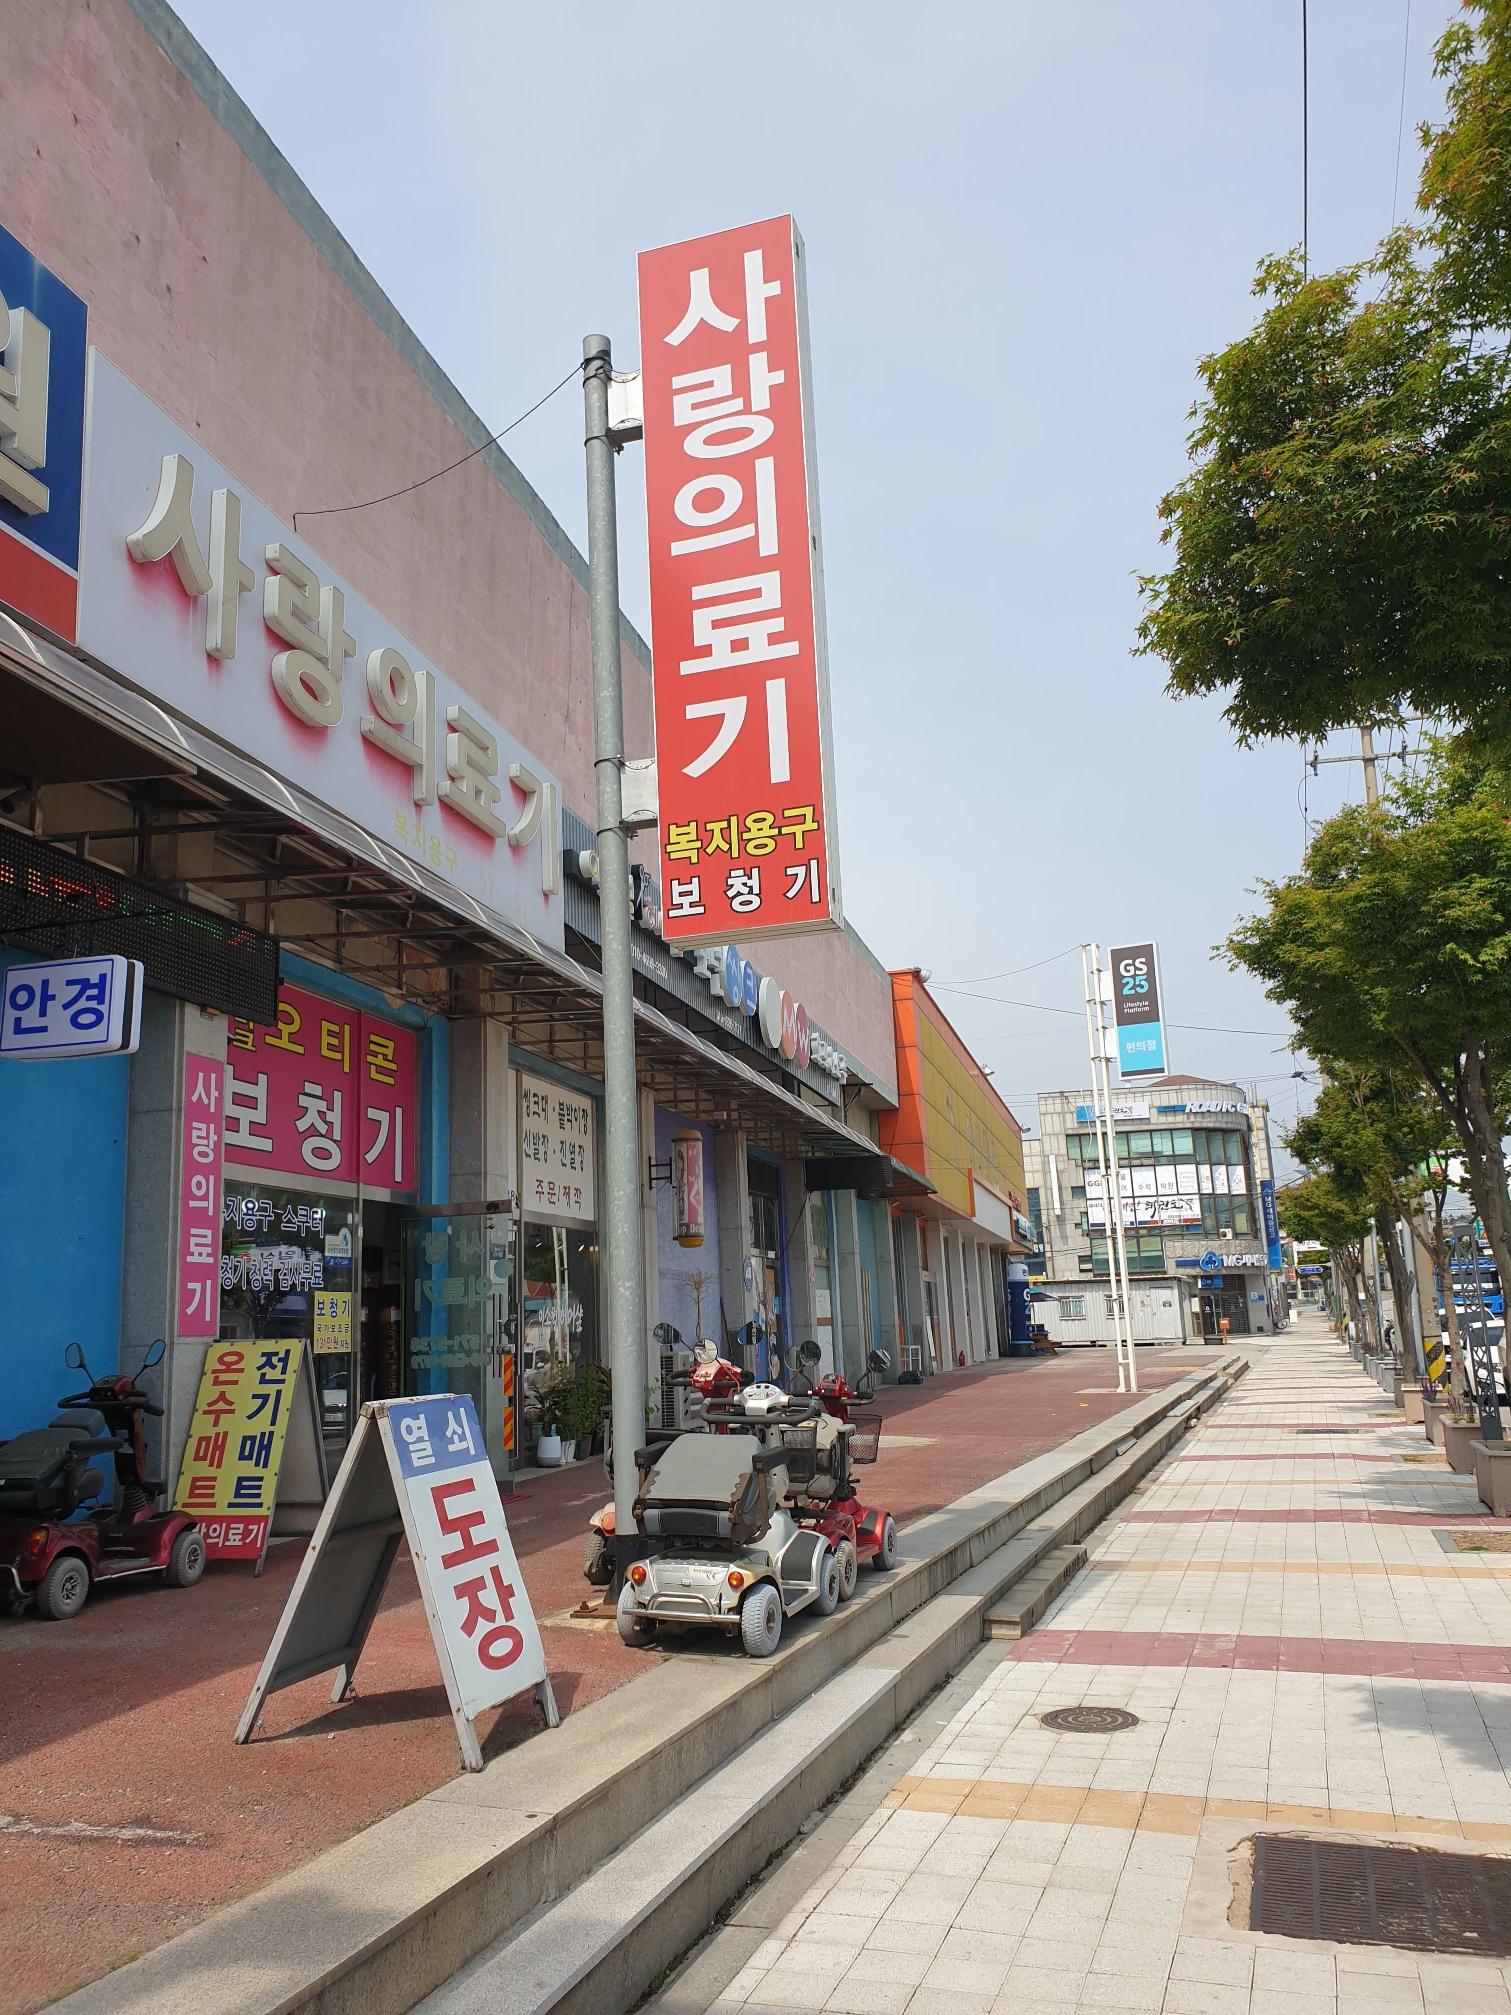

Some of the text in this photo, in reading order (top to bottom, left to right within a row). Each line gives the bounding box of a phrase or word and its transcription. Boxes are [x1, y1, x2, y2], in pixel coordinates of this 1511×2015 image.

[663, 248, 800, 785] 사랑의료기
[126, 453, 560, 895] 사랑의료기
[394, 810, 459, 873] 복지용구
[664, 804, 819, 864] 복지용구
[667, 859, 821, 919] 보청기
[1119, 957, 1148, 977] GS
[1121, 974, 1149, 996] 25
[8, 972, 108, 1036] 안경
[1123, 1000, 1149, 1009] Lifestyle
[1123, 1006, 1150, 1014] Platform
[1125, 1040, 1157, 1053] 편의점
[225, 1063, 403, 1184] 보청기
[523, 1128, 585, 1173] 신발장 진열장
[185, 1072, 219, 1324] 사랑의료기
[222, 1196, 325, 1239] 지용구 스쿠터
[316, 1298, 350, 1319] 보청기
[181, 1350, 245, 1509] 온수매트
[227, 1349, 290, 1509] 전기매트
[400, 1406, 476, 1468] 열쇠
[430, 1477, 524, 1671] 도장
